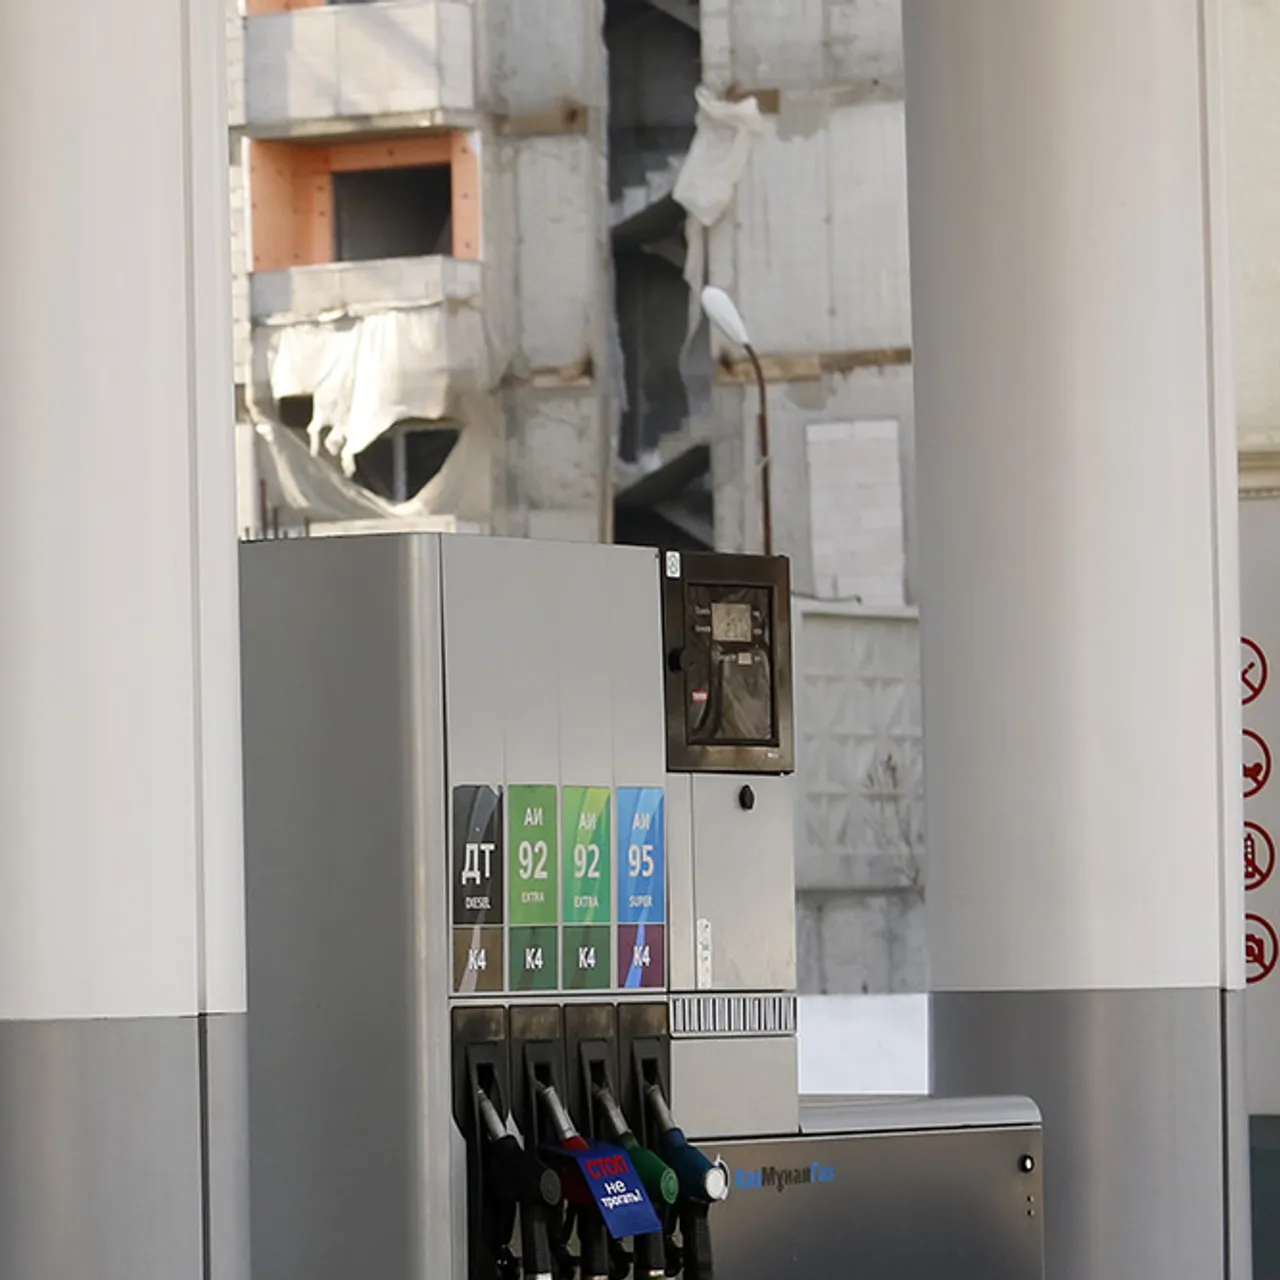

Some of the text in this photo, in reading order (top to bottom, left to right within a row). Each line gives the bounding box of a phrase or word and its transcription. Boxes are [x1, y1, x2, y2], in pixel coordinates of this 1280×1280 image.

[524, 807, 543, 826] АИ
[462, 843, 495, 885] ДТ
[519, 841, 548, 879] 92
[574, 845, 600, 879] 92
[628, 844, 654, 877] 95
